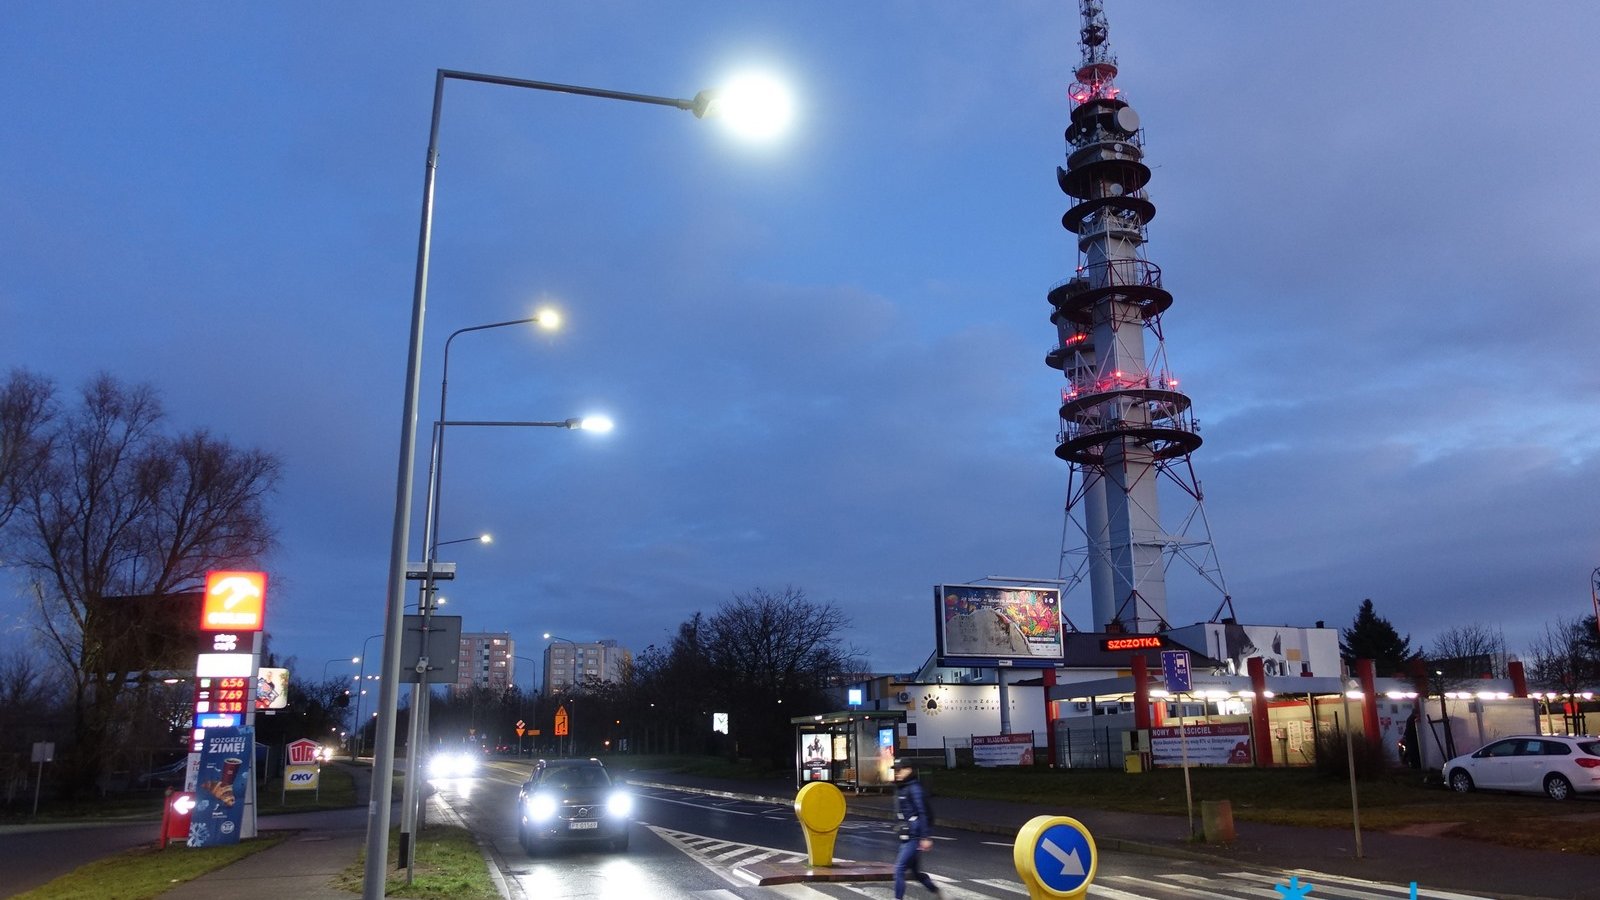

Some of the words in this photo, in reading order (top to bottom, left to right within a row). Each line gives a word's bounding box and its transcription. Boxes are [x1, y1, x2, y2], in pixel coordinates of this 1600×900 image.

[1108, 637, 1161, 650] SZCZOTKA
[221, 678, 245, 688] 6.56
[219, 689, 243, 700] 7.69
[218, 701, 242, 712] 3.18
[1152, 728, 1170, 737] NOWY
[208, 742, 246, 755] ZIMĘ!
[291, 741, 316, 762] UTA
[290, 773, 313, 782] DKV
